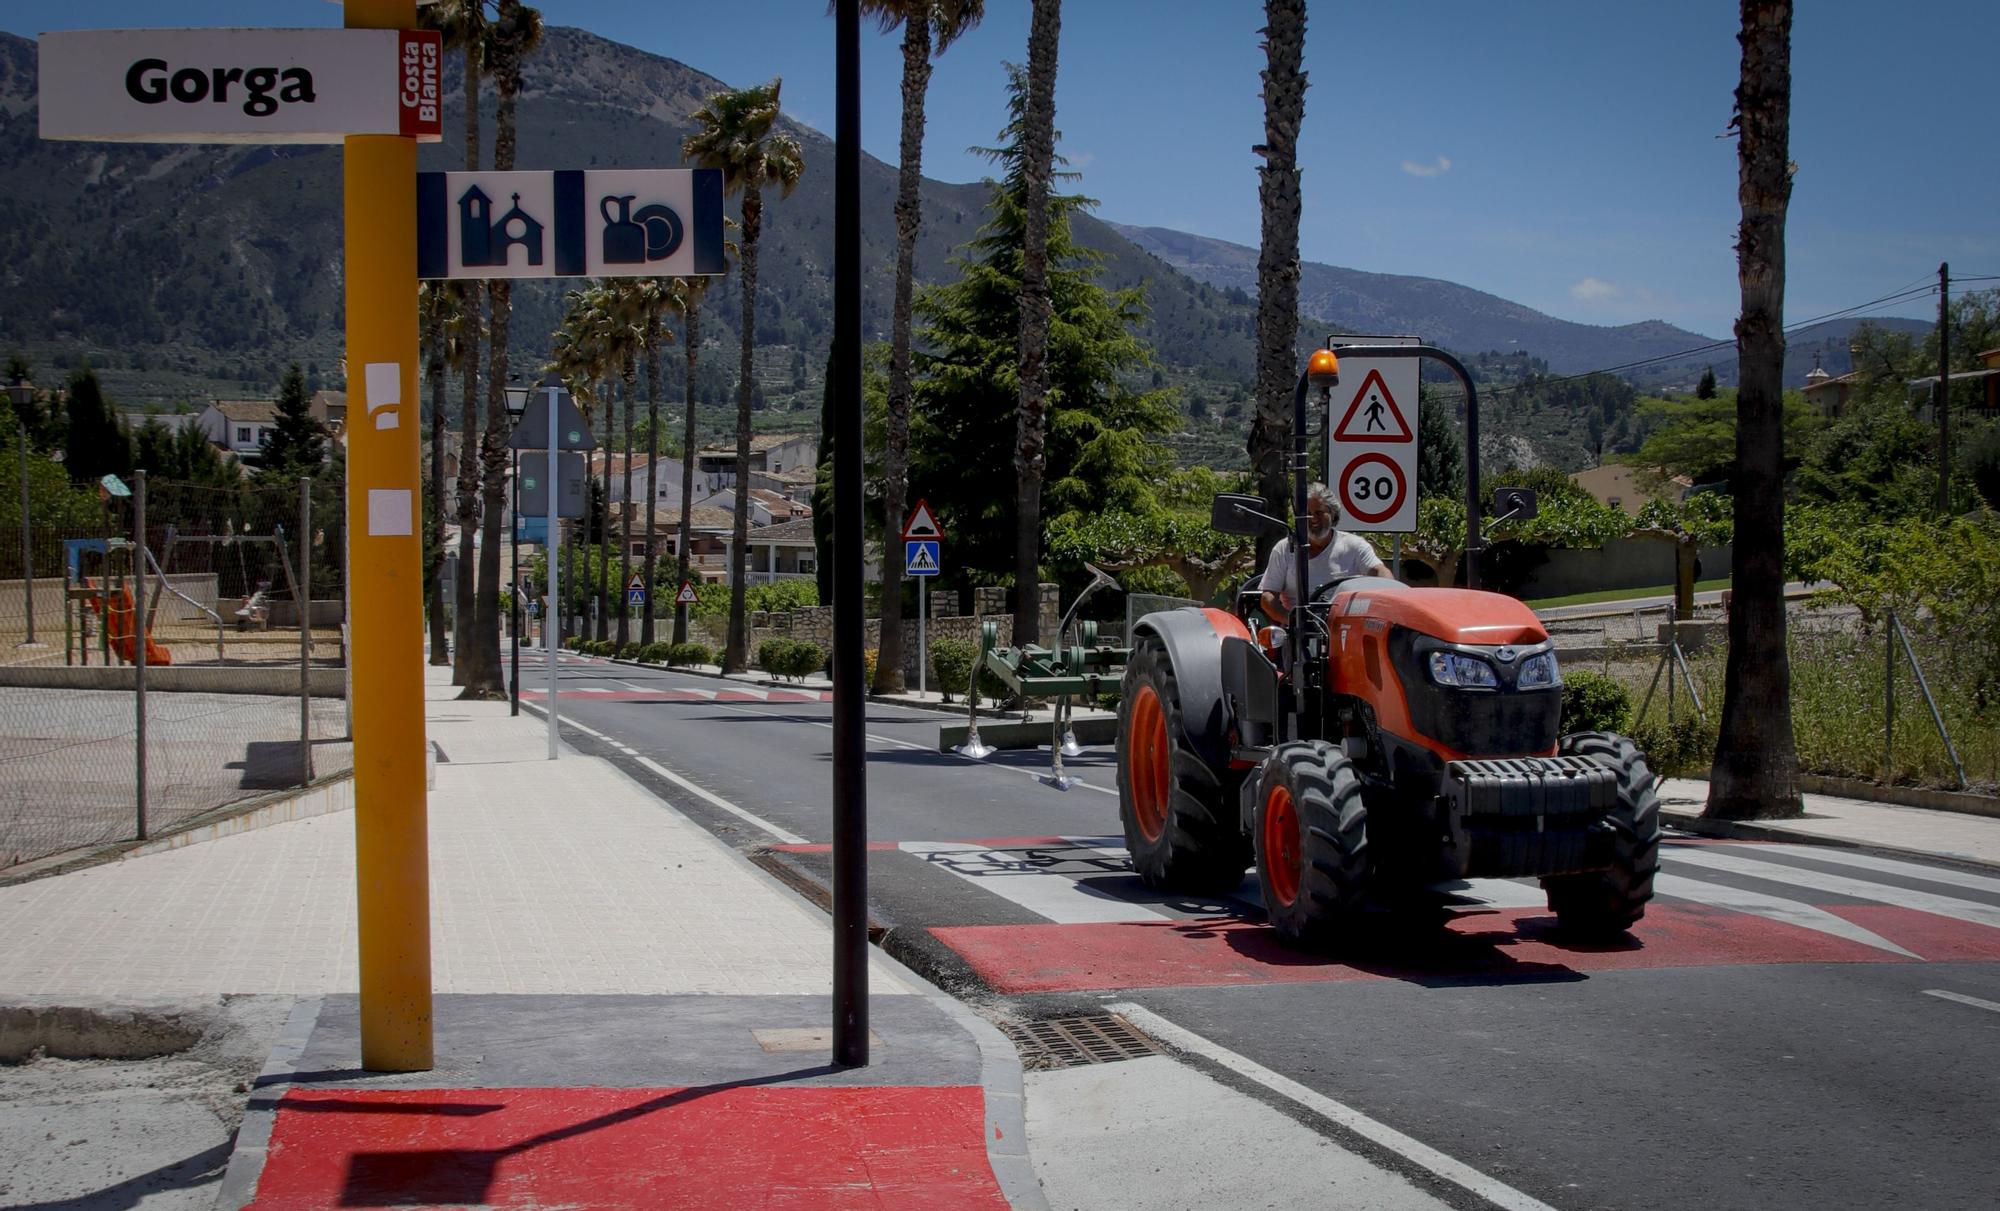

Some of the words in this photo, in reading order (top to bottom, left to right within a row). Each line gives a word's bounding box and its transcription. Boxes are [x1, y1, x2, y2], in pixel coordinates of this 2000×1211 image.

[125, 58, 316, 117] Gorga
[402, 41, 419, 108] Costa
[419, 42, 438, 122] Blanca
[1354, 477, 1393, 500] 30
